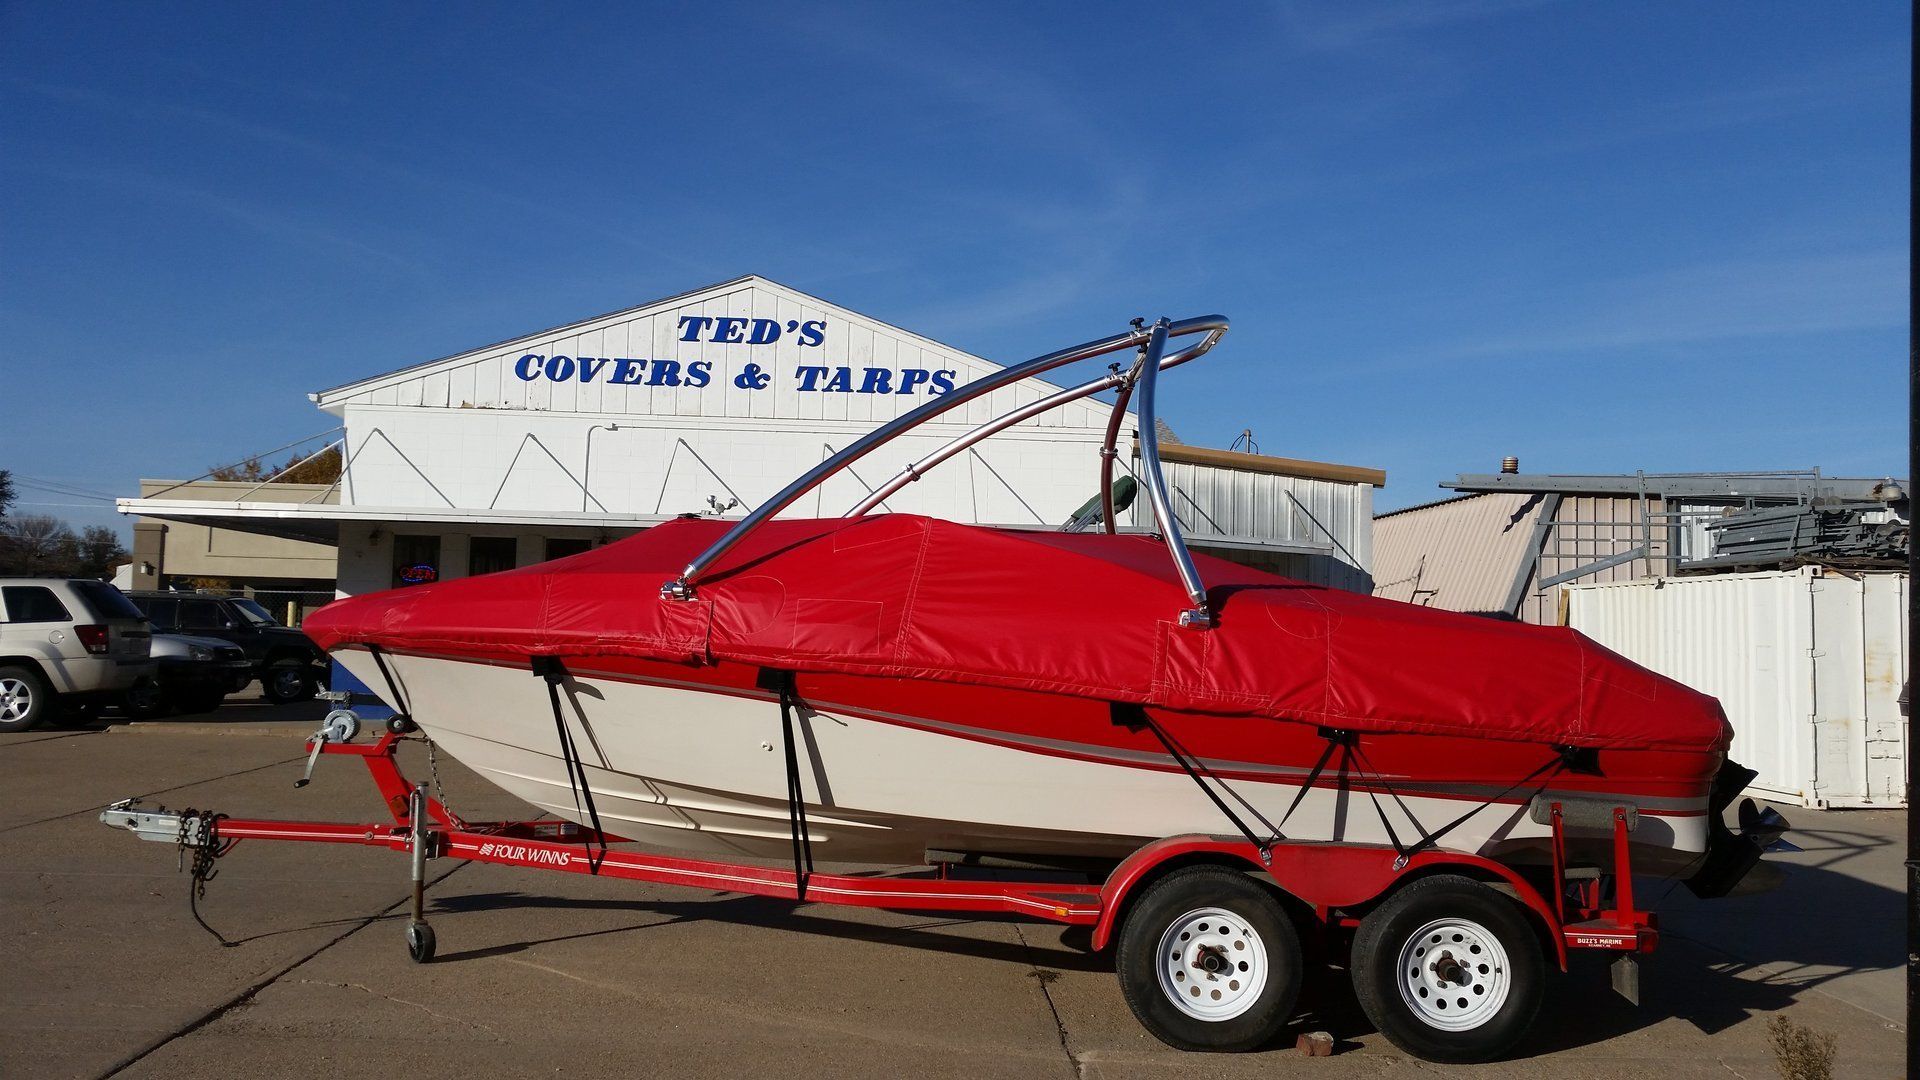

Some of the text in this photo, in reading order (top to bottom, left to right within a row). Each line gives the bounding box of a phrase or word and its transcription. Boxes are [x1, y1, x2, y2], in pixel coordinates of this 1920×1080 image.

[677, 315, 827, 347] TED'S
[514, 354, 957, 396] COVERS & TARPS
[493, 844, 570, 865] FOUR WINNS
